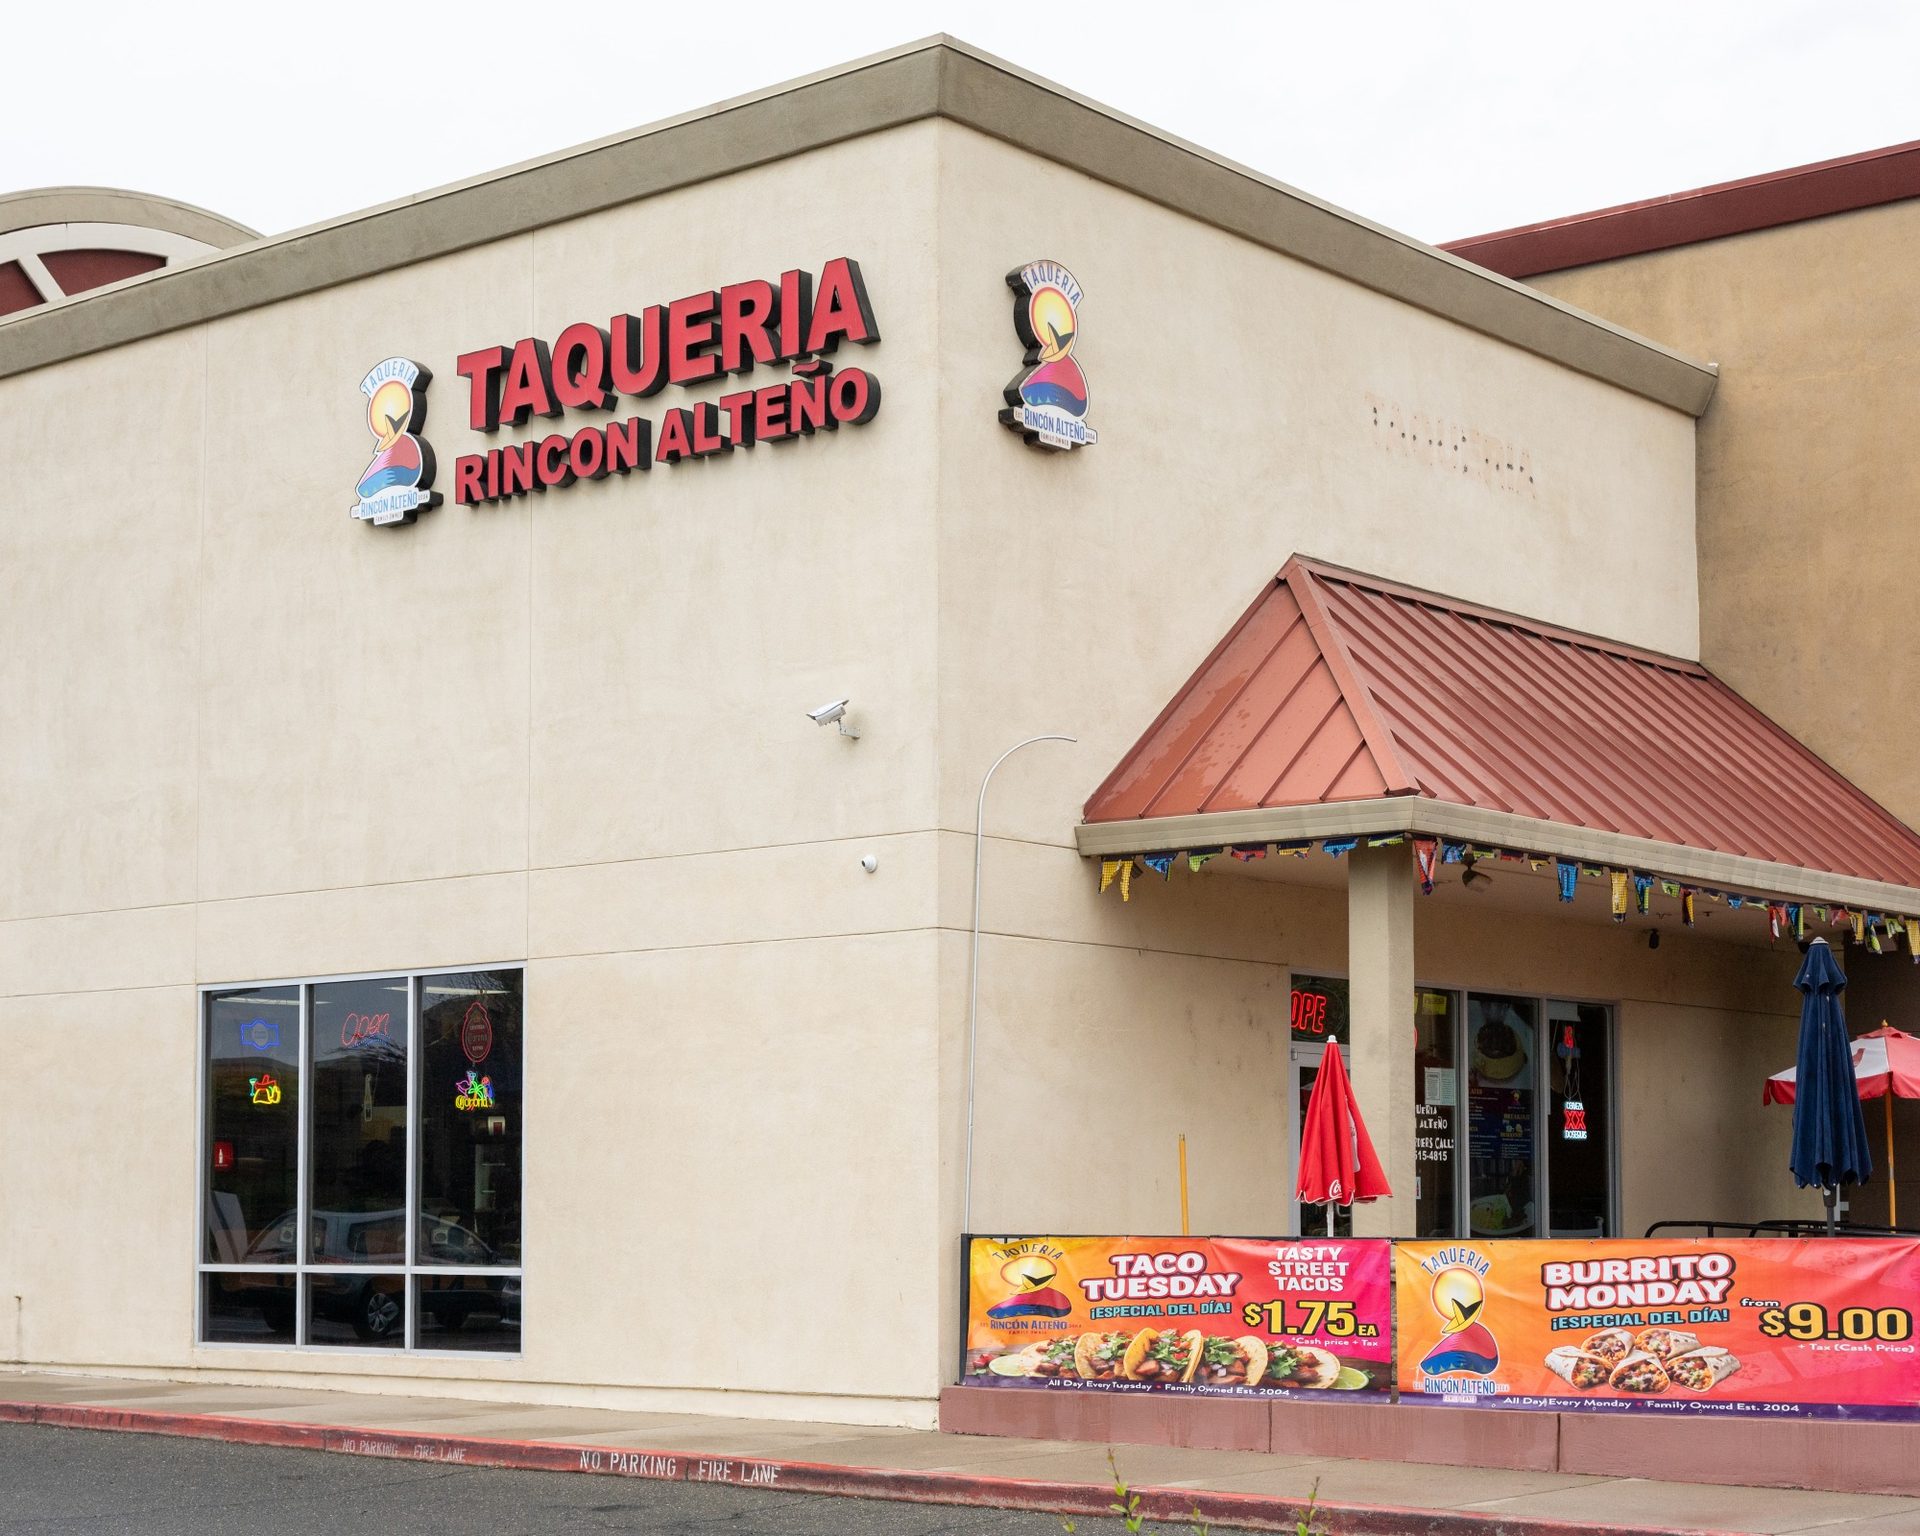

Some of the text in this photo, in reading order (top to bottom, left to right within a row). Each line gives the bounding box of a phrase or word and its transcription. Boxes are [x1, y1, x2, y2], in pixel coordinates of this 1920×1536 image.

[1023, 264, 1081, 305] TAQUERIA
[456, 256, 880, 432] TAQUERIA
[361, 359, 417, 395] TAQUERIA
[455, 359, 880, 506] RINCON ALTEÑO
[1024, 407, 1054, 432] RINCÓN
[1055, 417, 1085, 441] ALTEÑO
[361, 496, 389, 517] RINCÓN
[390, 489, 418, 509] ALTEÑO
[341, 1013, 390, 1046] Open
[1415, 1104, 1438, 1115] UERIA
[1564, 1110, 1586, 1130] XX
[1415, 1137, 1434, 1149] DERS
[992, 1243, 1064, 1260] TAQUERIA
[1275, 1246, 1343, 1261] TASTY
[1420, 1247, 1491, 1277] TAQUERIA
[1110, 1251, 1206, 1277] TACO
[1267, 1261, 1350, 1277] STREET
[1542, 1252, 1735, 1286] BURRITO
[1080, 1273, 1242, 1301] TUESDAY
[1274, 1276, 1344, 1292] TACOS
[1547, 1278, 1735, 1311] MONDAY
[1090, 1300, 1232, 1319] ¡ESPECIAL DEL DÍA!
[1740, 1298, 1780, 1308] from
[990, 1319, 1029, 1330] RINCÓN
[1031, 1319, 1068, 1330] ALTEÑO
[1243, 1299, 1379, 1337] $1.75 EA
[1551, 1307, 1730, 1331] ¡ESPECIAL DEL DÍA!
[1759, 1302, 1912, 1342] $9.00
[1324, 1338, 1350, 1347] price
[1361, 1339, 1378, 1347] Tax
[1809, 1343, 1831, 1351] Tax
[1834, 1343, 1873, 1352] (Cash
[1876, 1344, 1915, 1353] Price)
[1048, 1379, 1290, 1396] All Day Every Tuesday Family Owned Est. 2004
[1424, 1376, 1496, 1395] RINCÓN ALTEÑO
[1503, 1397, 1800, 1412] All Day Every Monday Family Owned Est. 2004
[342, 1439, 467, 1461] NO PARKING FIRE LANE
[579, 1450, 782, 1485] NO PARKING FIRE LANE
